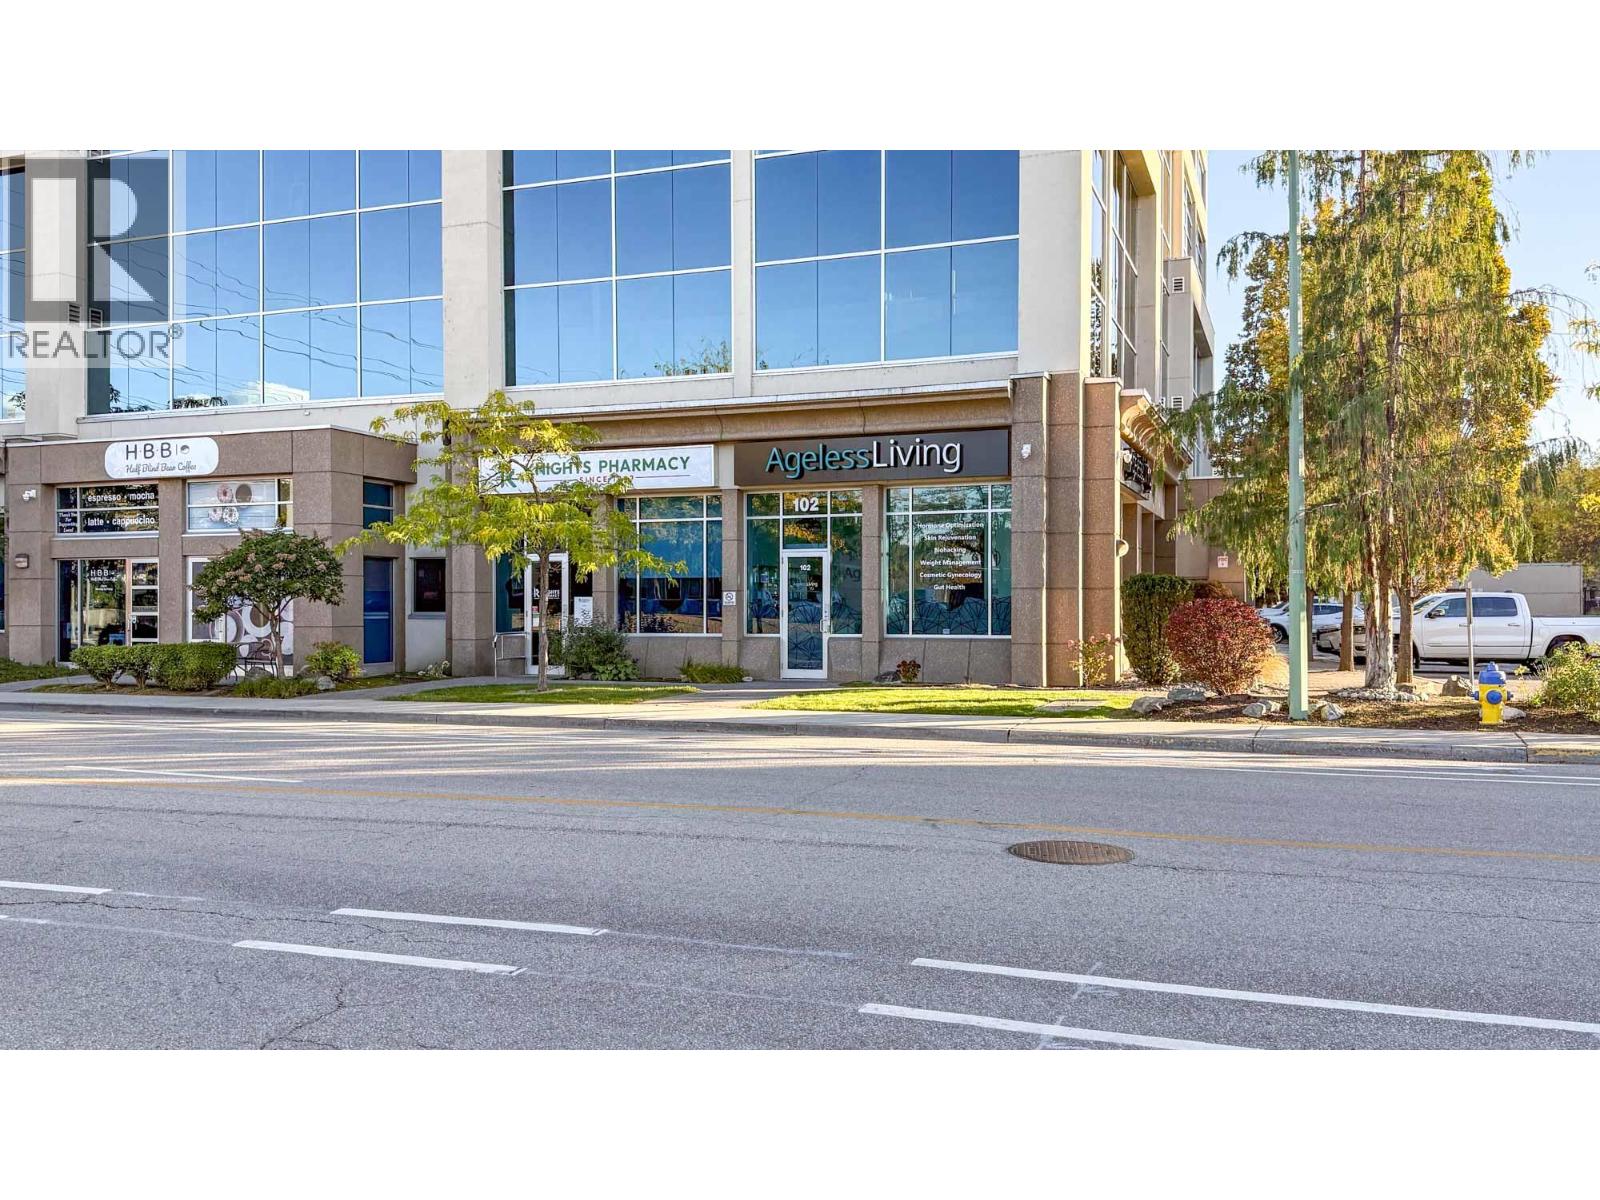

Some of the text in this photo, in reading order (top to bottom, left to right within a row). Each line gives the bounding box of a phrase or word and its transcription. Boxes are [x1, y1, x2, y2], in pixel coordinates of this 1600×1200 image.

[125, 463, 141, 475] Half
[142, 463, 160, 473] Blind
[177, 461, 197, 473] Coffee
[598, 456, 690, 473] PHARMACY
[579, 475, 608, 483] SINCE
[87, 491, 155, 504] espresso mocha
[793, 497, 819, 512] 102
[87, 517, 104, 526] latte
[945, 521, 984, 529] Optimization
[938, 534, 977, 542] Rejuvenation
[920, 559, 982, 567] Weight Management
[947, 571, 982, 579] Gynecology
